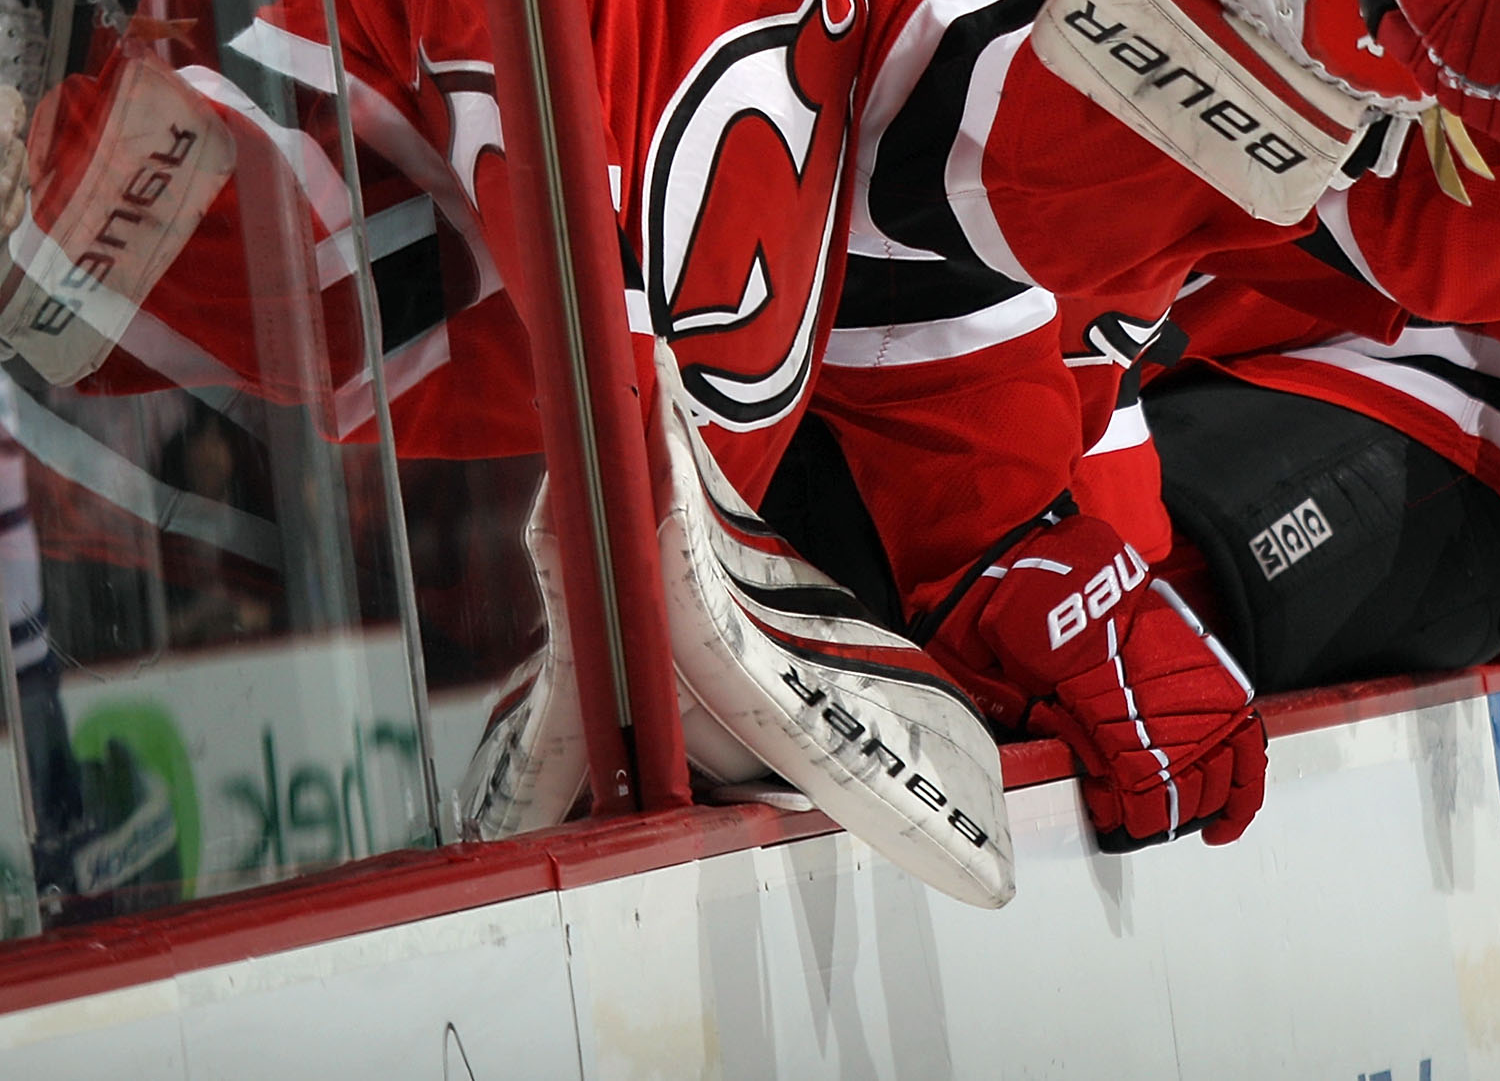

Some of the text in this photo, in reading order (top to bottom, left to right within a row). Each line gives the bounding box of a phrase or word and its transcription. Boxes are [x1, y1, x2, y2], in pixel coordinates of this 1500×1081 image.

[1064, 0, 1307, 175] BAUER
[1047, 542, 1150, 651] BAU
[1252, 505, 1329, 577] CCM
[779, 663, 989, 849] BAUER
